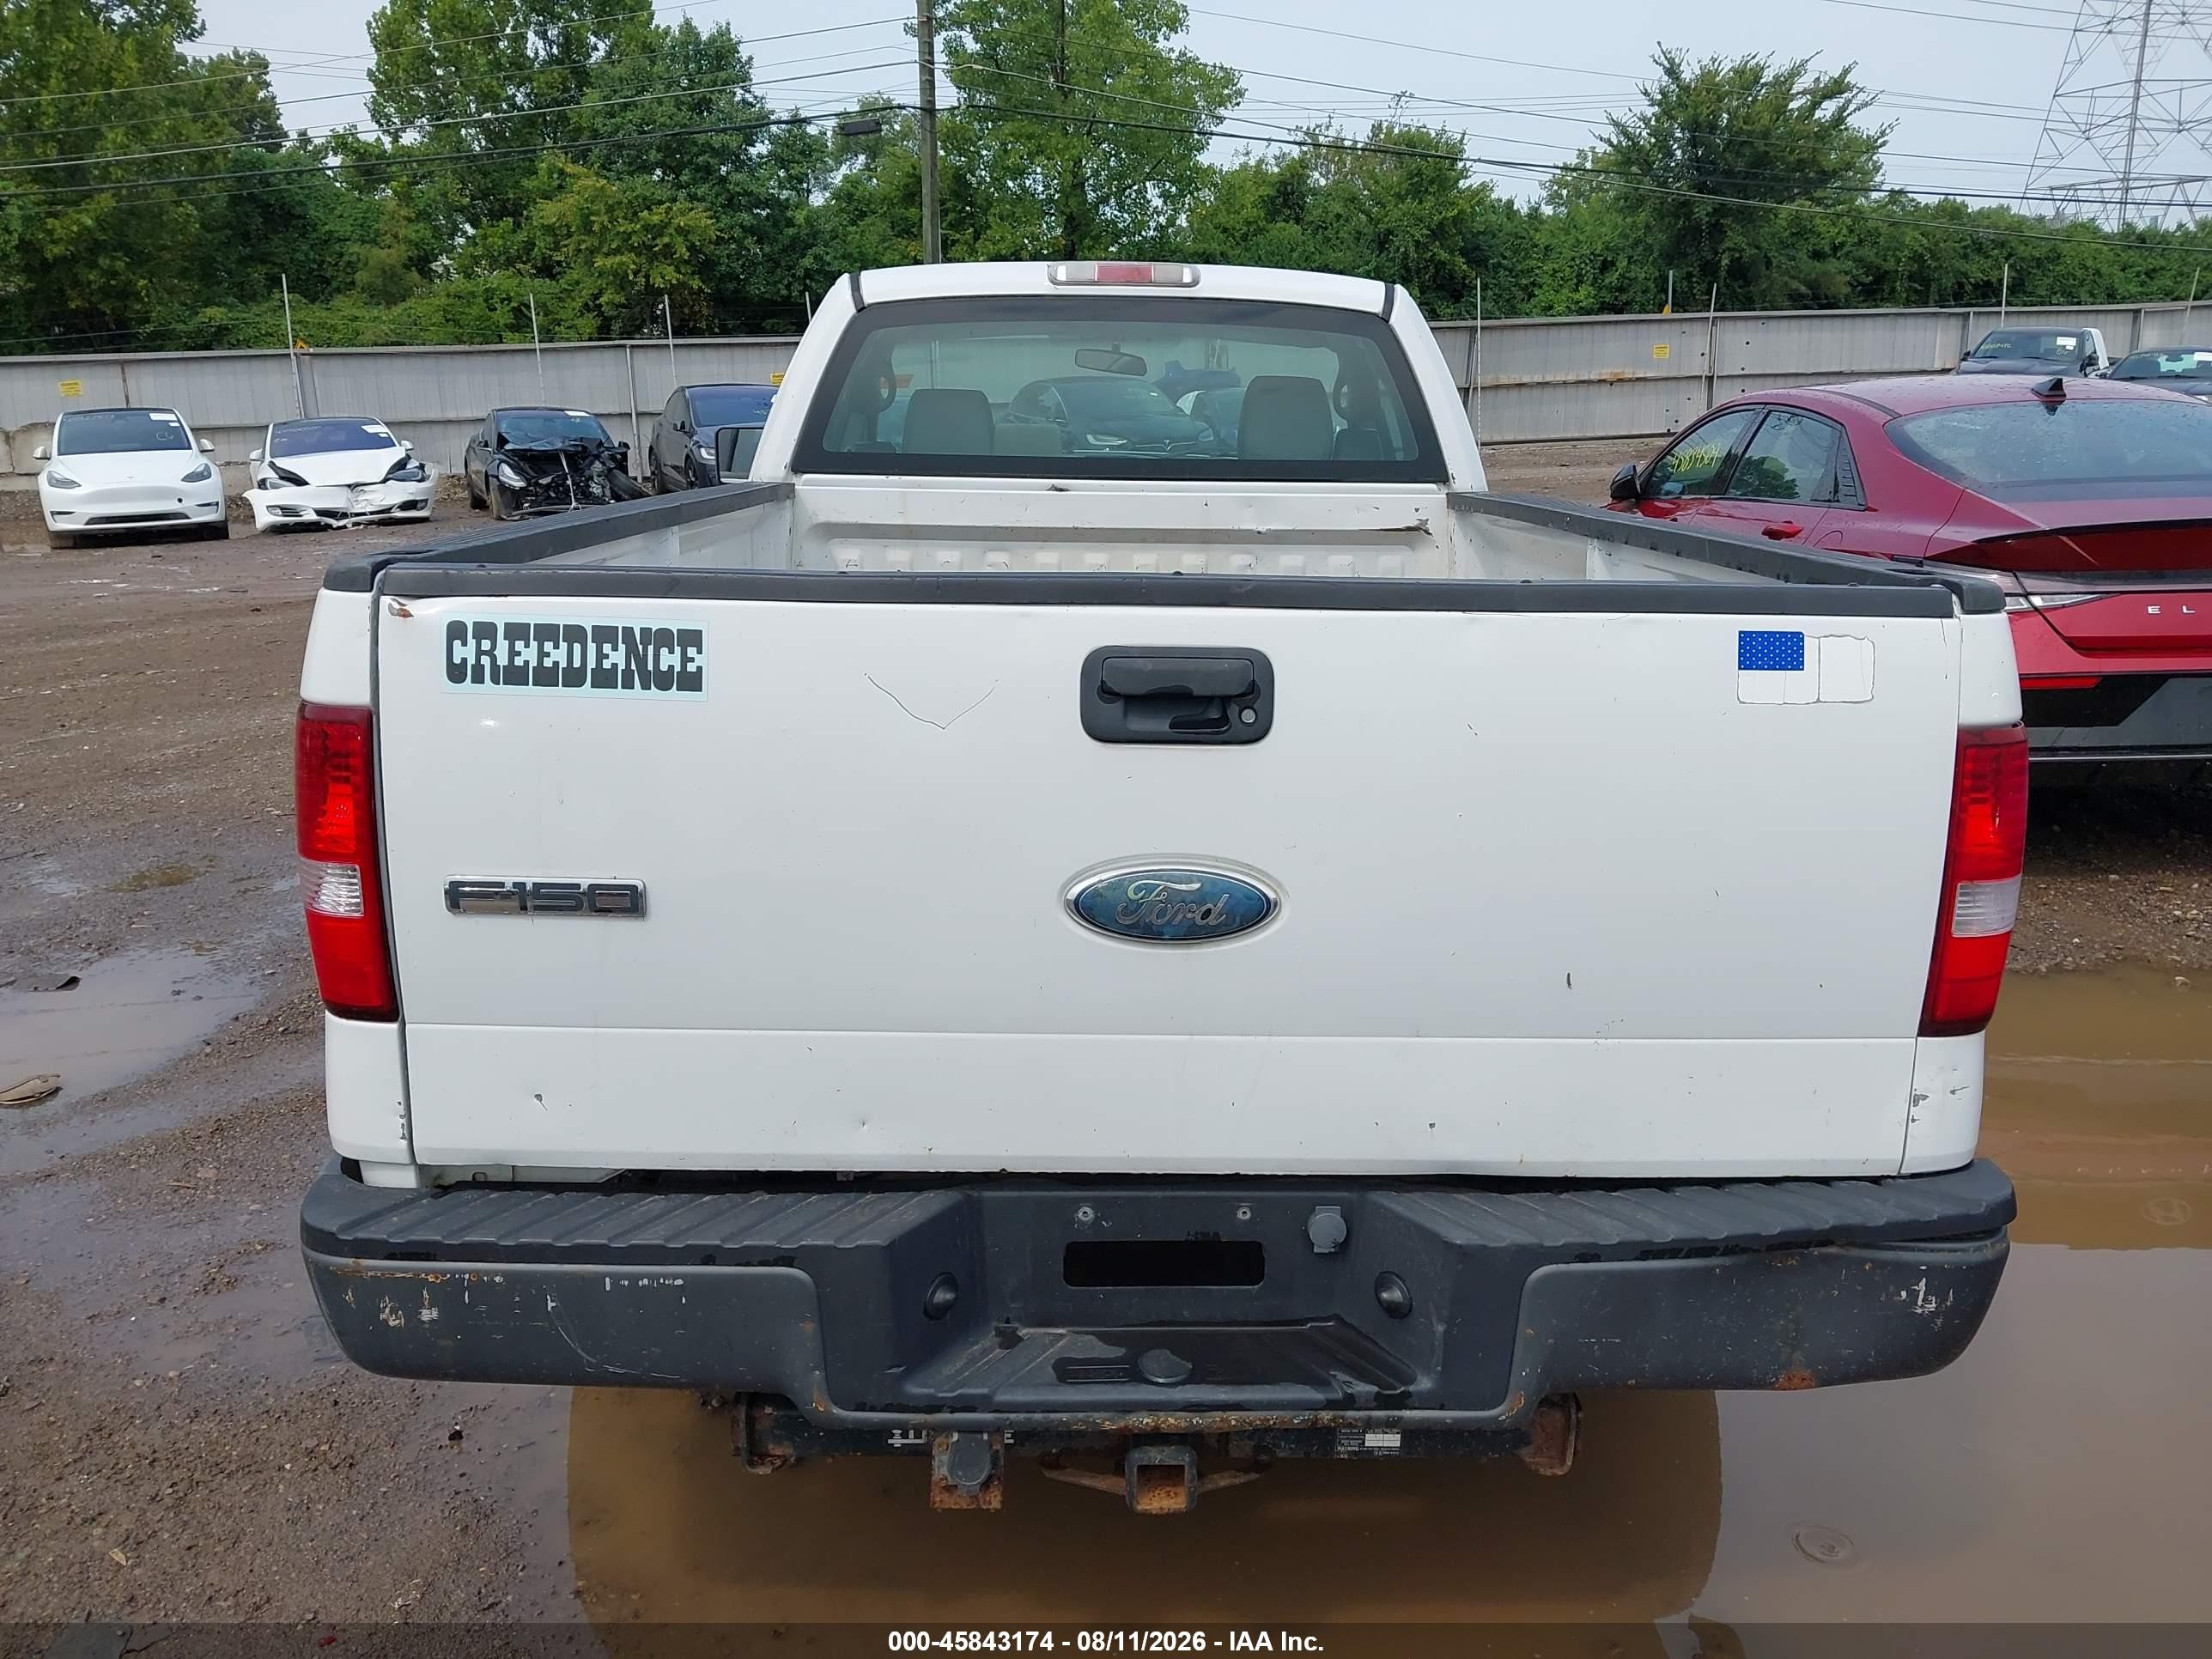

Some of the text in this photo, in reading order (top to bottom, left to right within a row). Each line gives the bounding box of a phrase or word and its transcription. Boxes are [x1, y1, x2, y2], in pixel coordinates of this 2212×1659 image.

[446, 619, 703, 692] CREEDENCE
[446, 879, 641, 914] F-150
[1115, 879, 1230, 926] Ford
